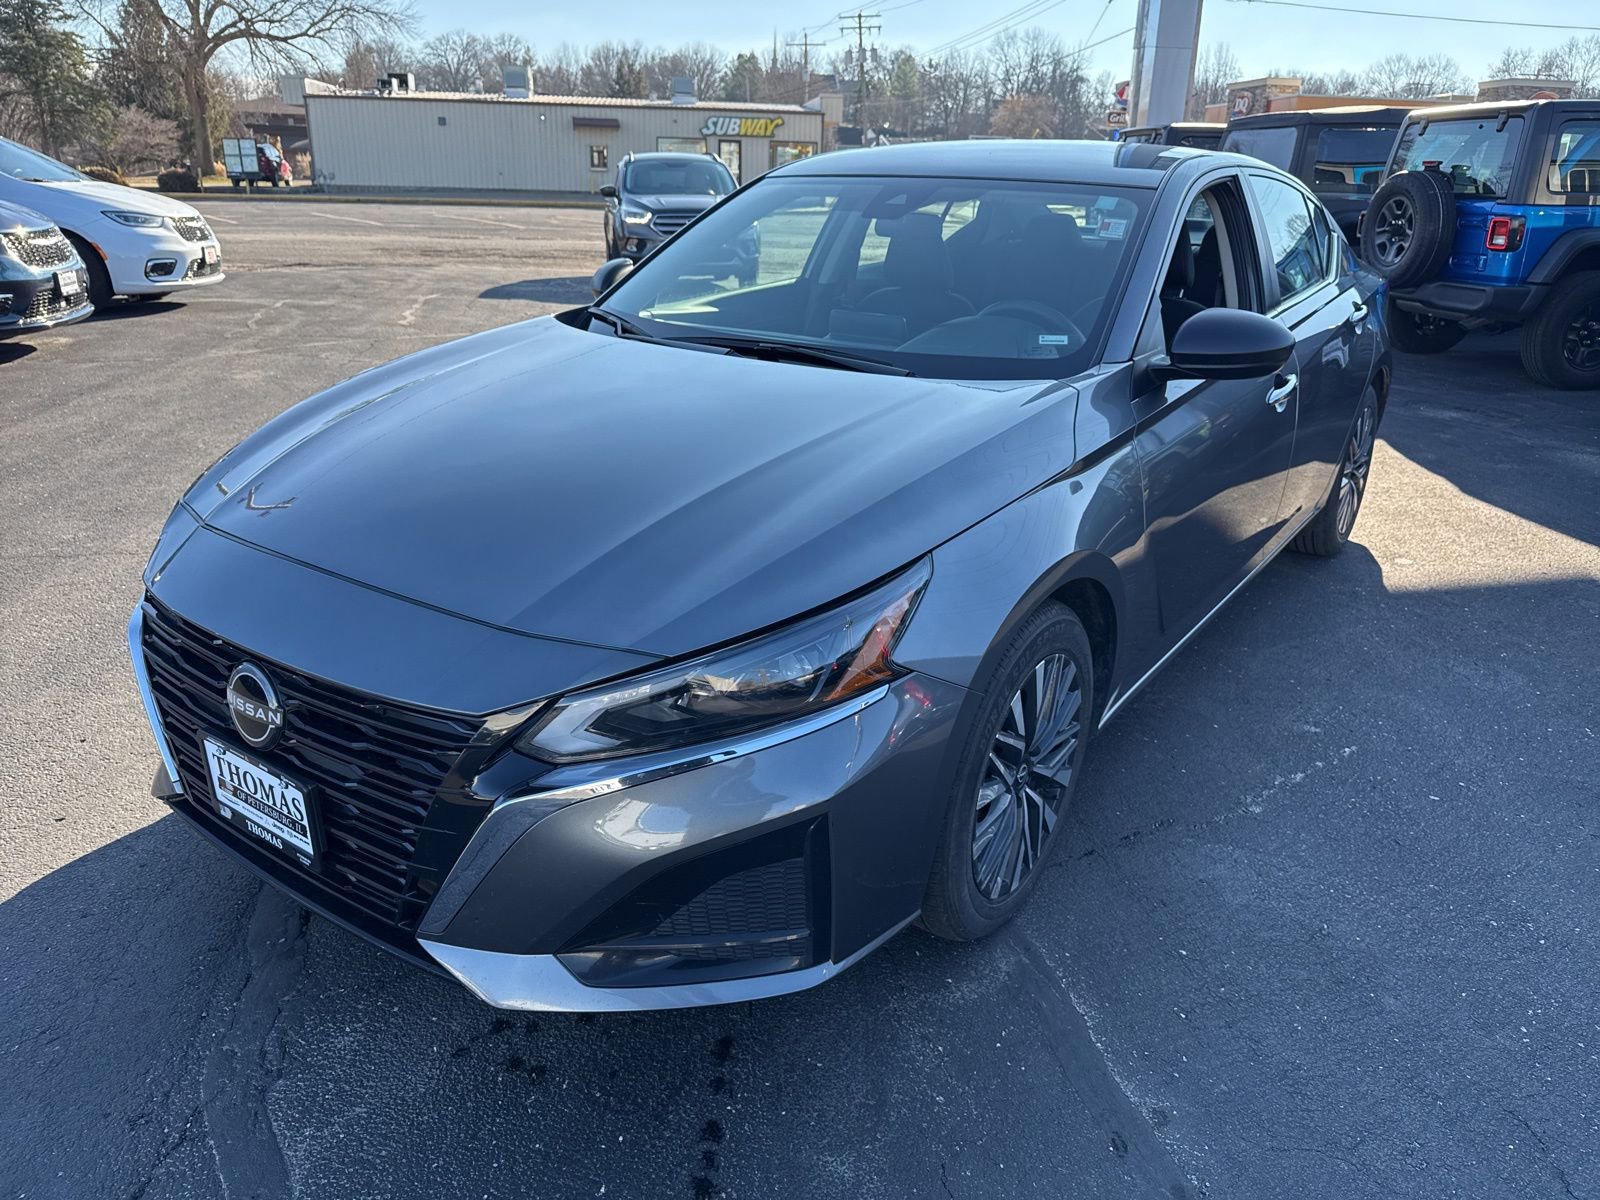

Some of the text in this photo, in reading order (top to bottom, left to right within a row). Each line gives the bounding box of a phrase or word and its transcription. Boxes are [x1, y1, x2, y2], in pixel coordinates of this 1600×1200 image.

[1234, 97, 1249, 113] DQ
[701, 116, 784, 137] SUBWAY
[229, 691, 281, 725] NISSAN
[212, 752, 304, 822] THOMAS
[237, 790, 247, 801] OF
[247, 795, 295, 830] PETERSBURG,
[295, 822, 304, 834] IL
[246, 819, 283, 849] THOMAS
